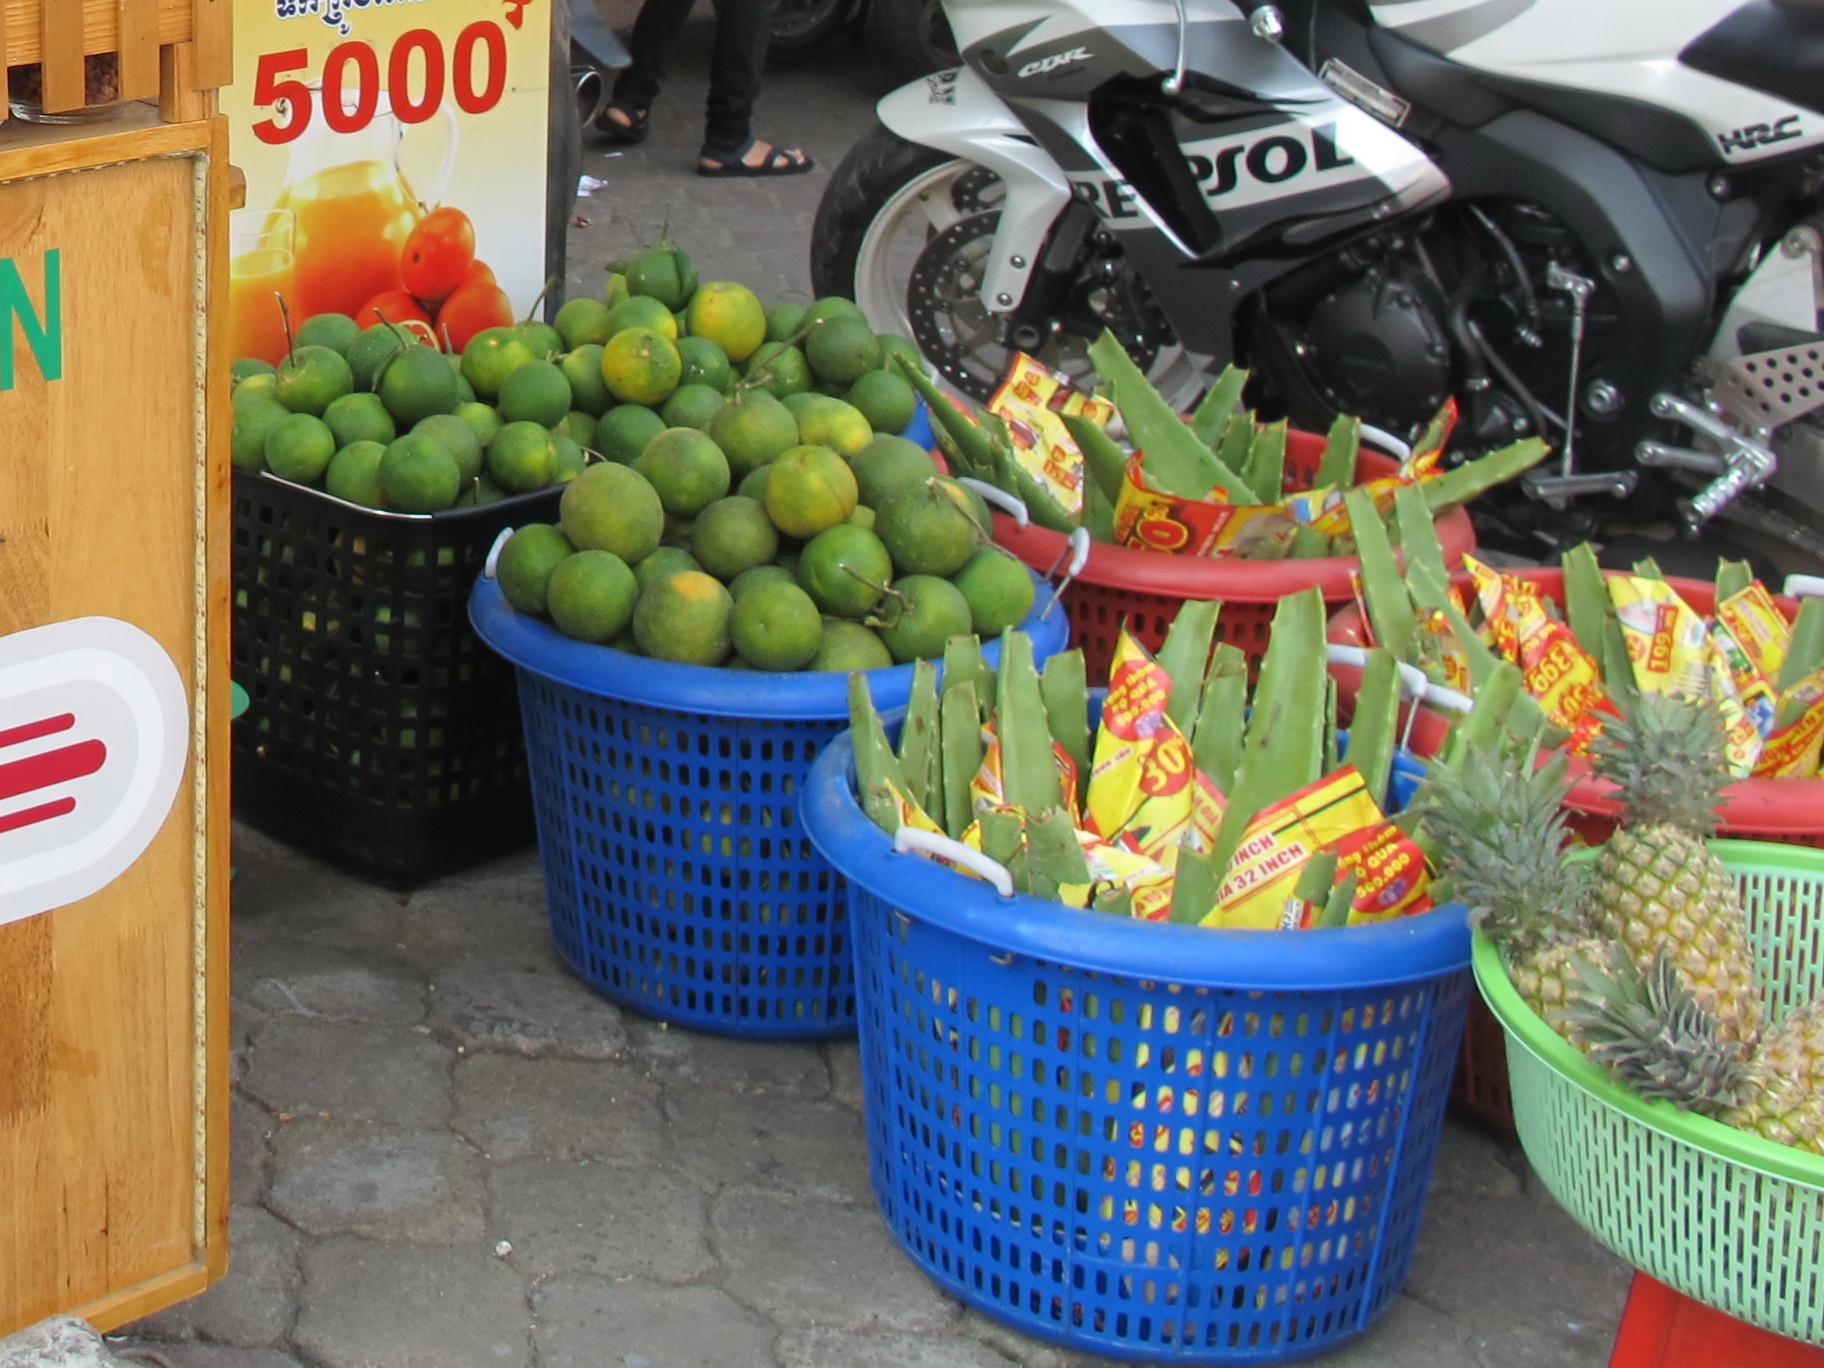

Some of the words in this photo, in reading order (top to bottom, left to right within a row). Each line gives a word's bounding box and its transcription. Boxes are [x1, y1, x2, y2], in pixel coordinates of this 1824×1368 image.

[252, 20, 507, 145] 5000
[1017, 46, 1095, 79] CBR
[1716, 114, 1805, 158] HRC
[1234, 834, 1277, 867] INCH
[1234, 869, 1258, 891] 32
[1259, 843, 1305, 876] INCH
